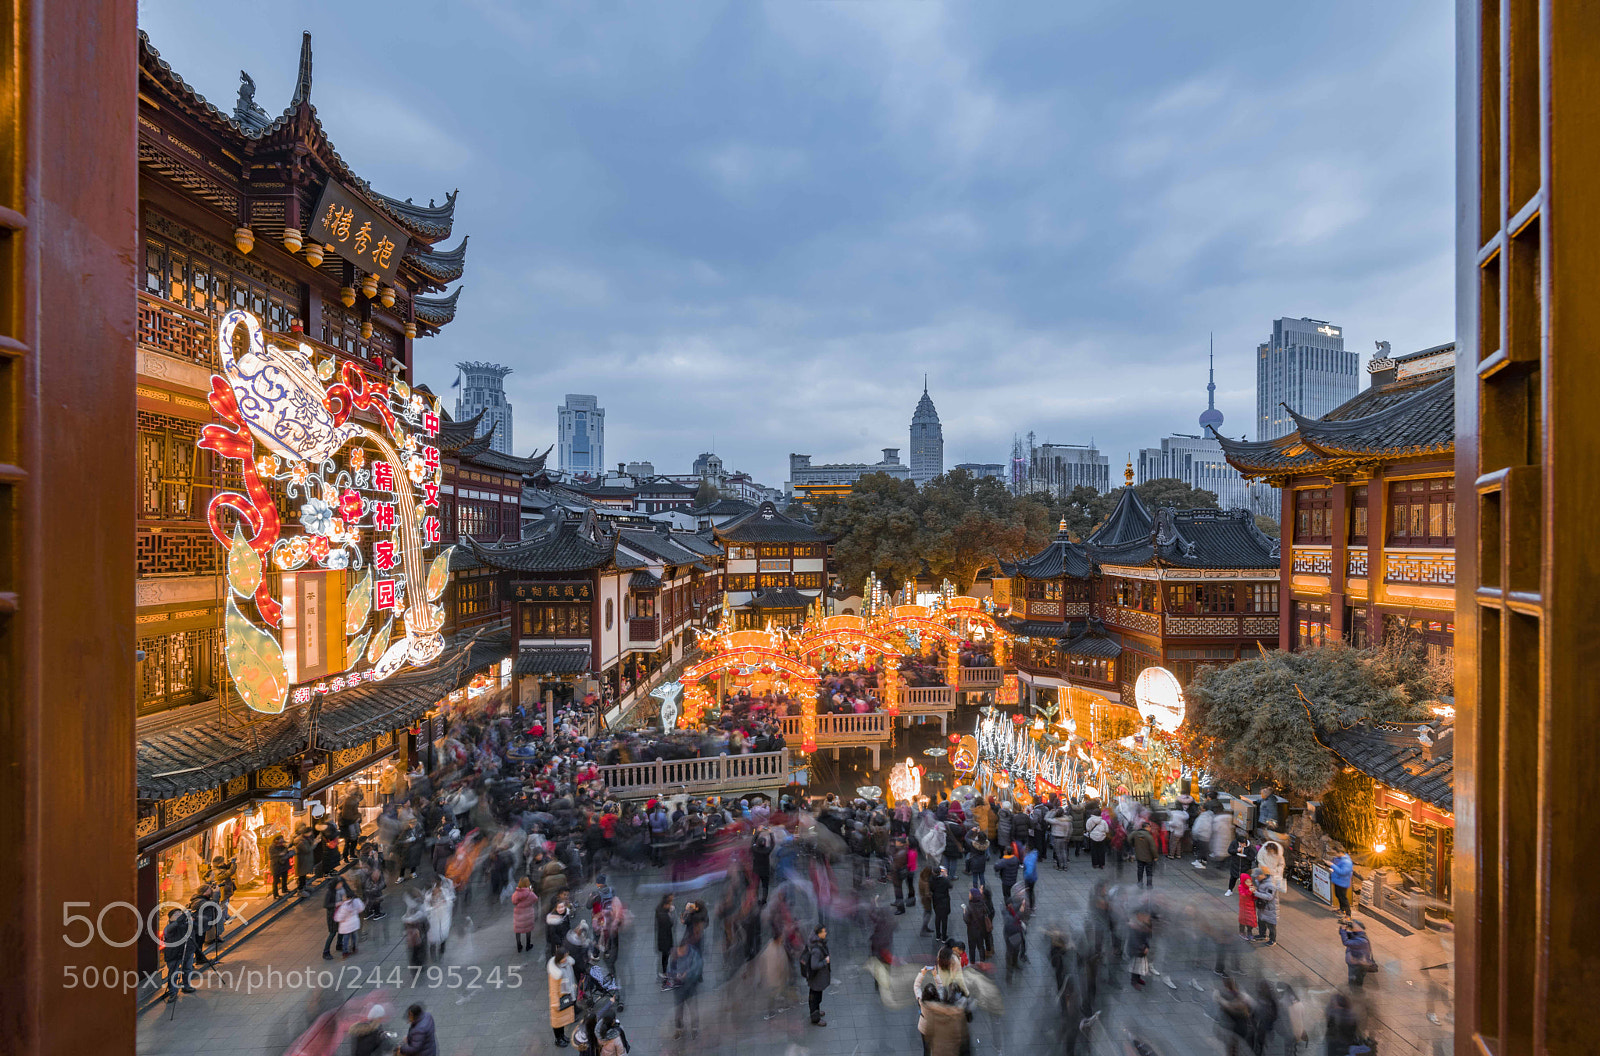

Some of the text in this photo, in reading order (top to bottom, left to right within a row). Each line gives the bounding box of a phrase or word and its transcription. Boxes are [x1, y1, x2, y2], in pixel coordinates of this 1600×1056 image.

[374, 461, 395, 610] 精神家园
[423, 411, 440, 543] 中华文化
